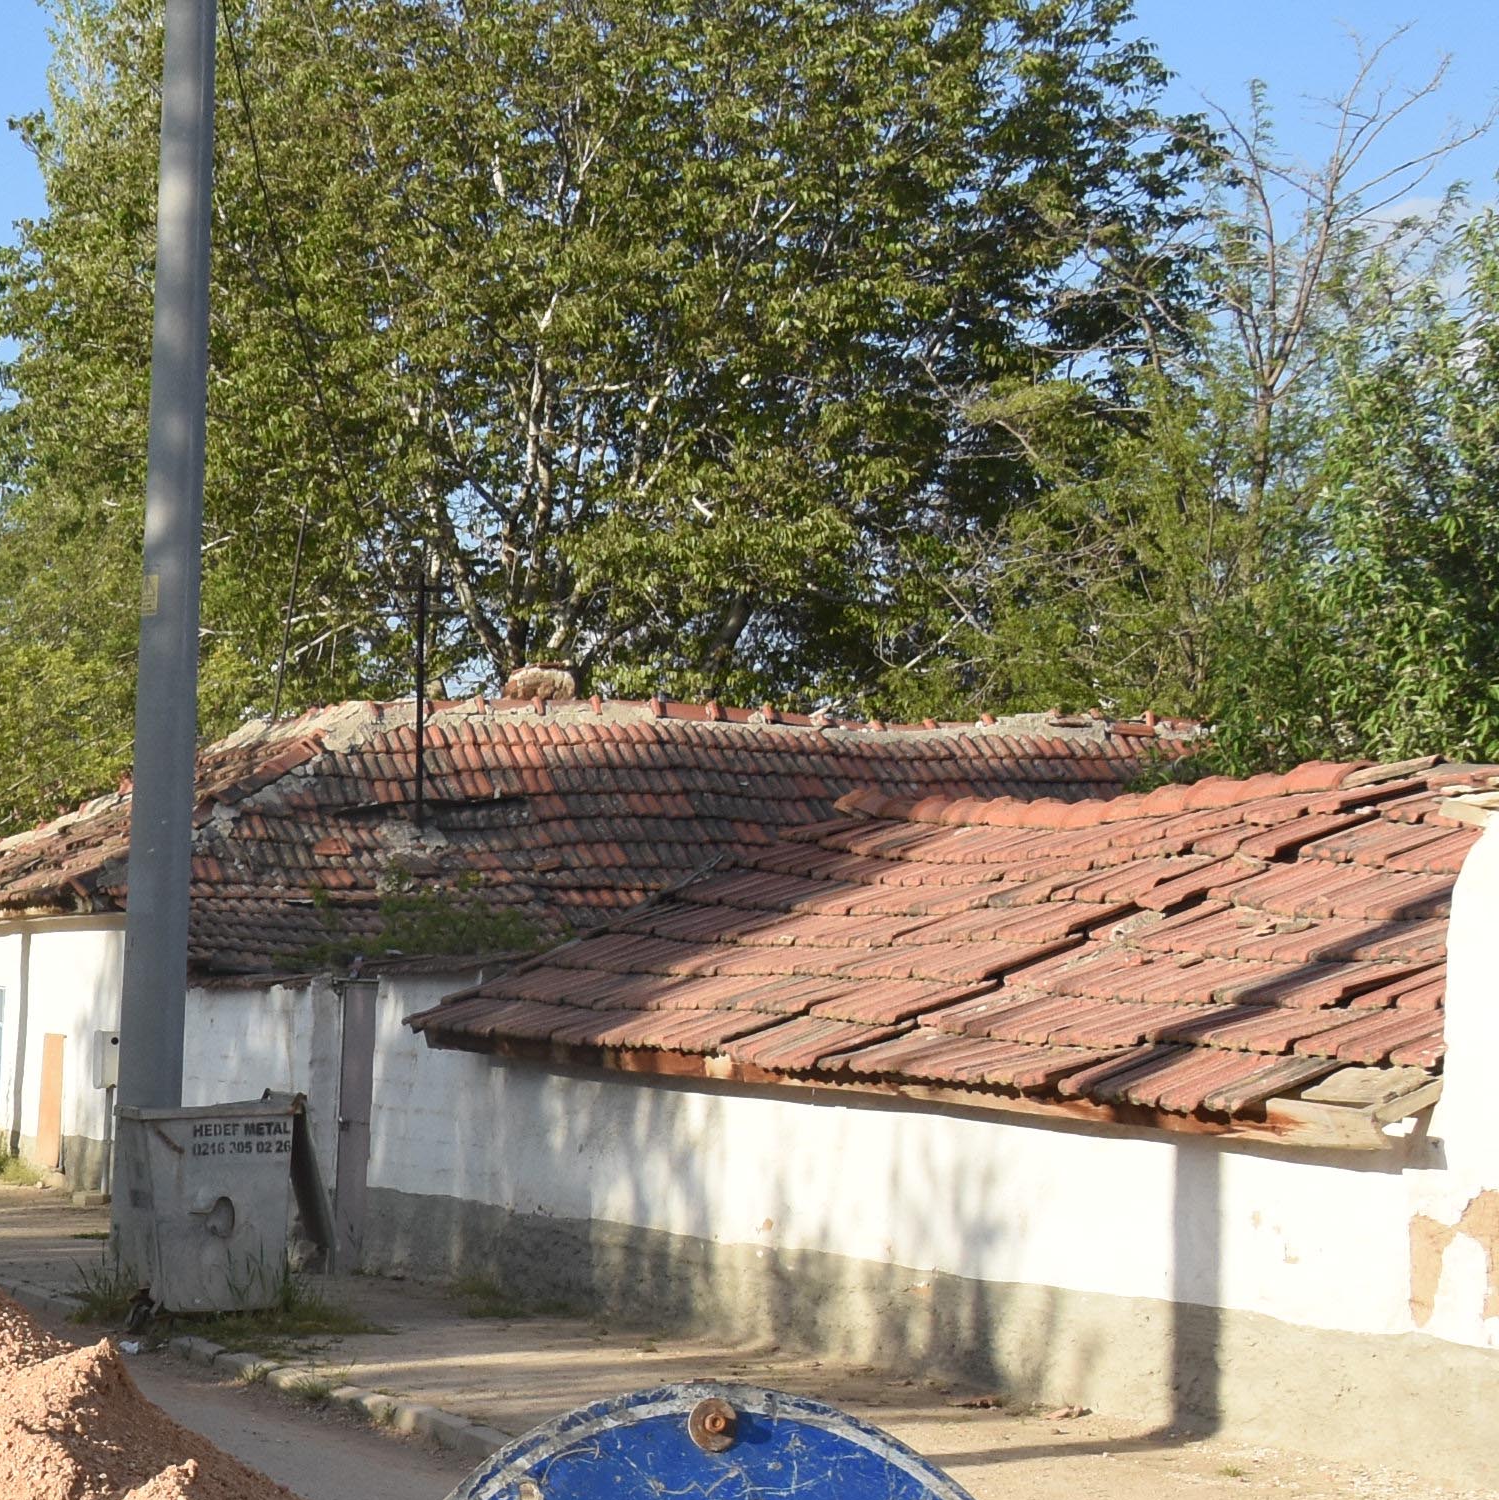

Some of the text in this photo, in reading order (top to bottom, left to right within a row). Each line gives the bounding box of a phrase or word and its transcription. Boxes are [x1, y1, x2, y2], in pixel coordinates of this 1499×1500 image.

[193, 1121, 291, 1137] HEDEF METAL
[192, 1142, 225, 1156] 0216
[256, 1140, 273, 1153] 02
[275, 1140, 292, 1153] 26
